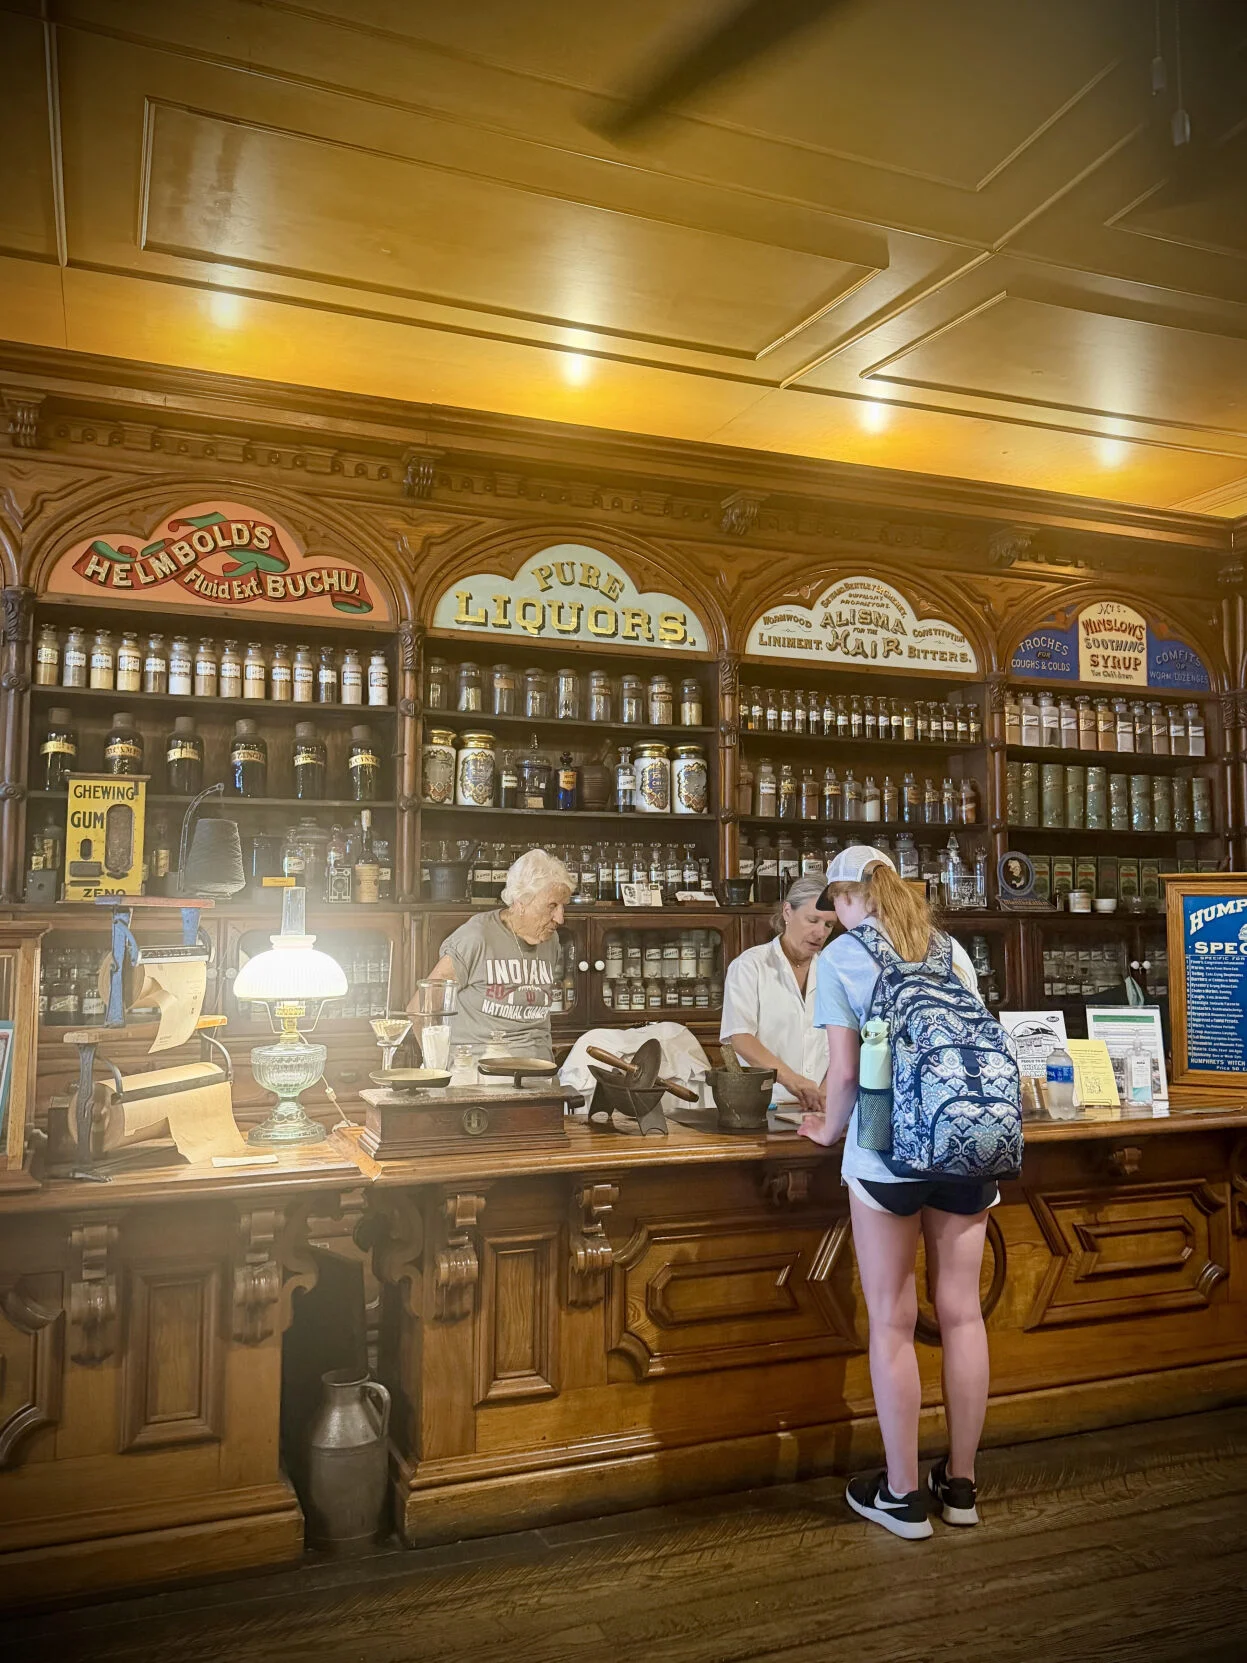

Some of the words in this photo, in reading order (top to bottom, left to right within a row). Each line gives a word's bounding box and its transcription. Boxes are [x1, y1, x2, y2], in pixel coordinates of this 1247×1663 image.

[84, 521, 273, 588] HELMBOLD'S
[183, 567, 231, 600] Fluid
[530, 560, 625, 603] PURE
[762, 613, 813, 629] WORMWOOD
[819, 608, 908, 637] ALISMA
[853, 627, 865, 636] FOR
[867, 628, 878, 636] THE
[912, 627, 967, 643] CONSTITUTION
[825, 629, 903, 659] HAIR
[1018, 636, 1069, 656] TROCHES
[1084, 637, 1146, 654] SOOTHING
[1011, 658, 1041, 670] COUGHS
[1041, 660, 1047, 670] &
[1047, 661, 1071, 672] COLDS
[1090, 654, 1142, 672] SYRUP
[1155, 649, 1202, 668] COMFITS
[70, 810, 104, 829] GUM
[481, 999, 523, 1019] NATIONAL
